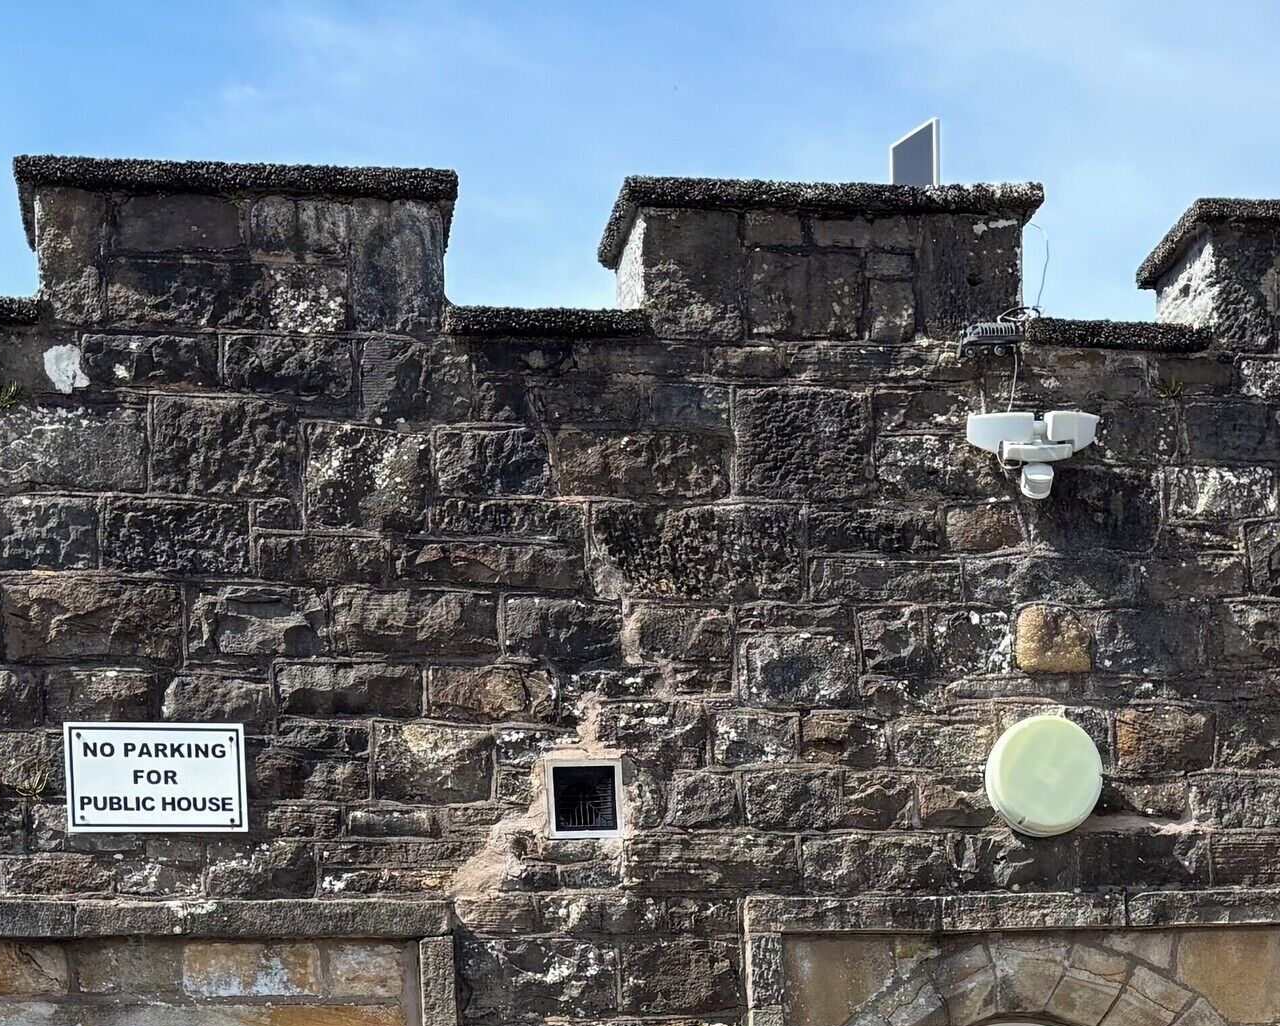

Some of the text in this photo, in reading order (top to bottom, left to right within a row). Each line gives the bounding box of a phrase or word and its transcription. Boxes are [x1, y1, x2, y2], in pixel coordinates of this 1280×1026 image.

[82, 741, 227, 759] NO PARKING
[132, 769, 179, 785] FOR
[79, 795, 234, 812] PUBLIC HOUSE
